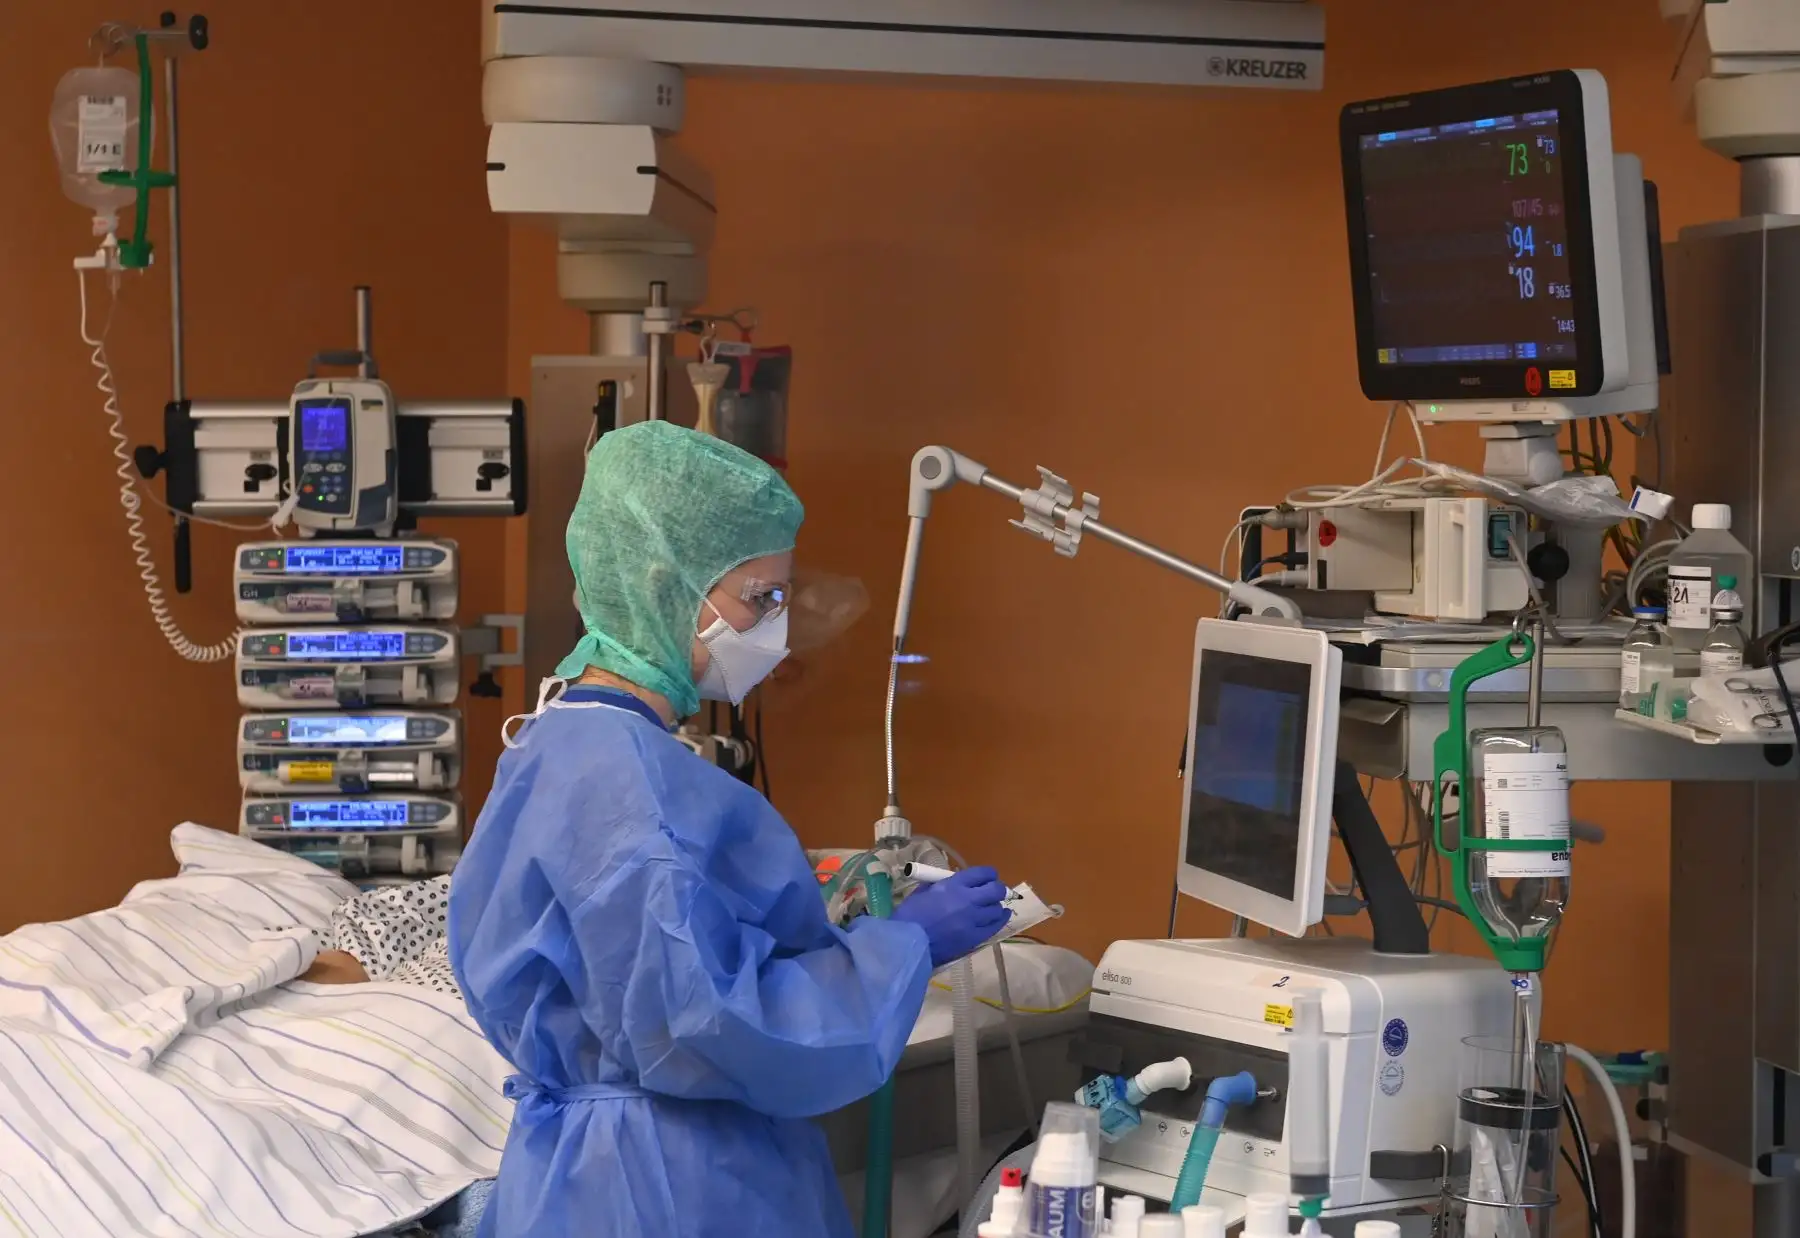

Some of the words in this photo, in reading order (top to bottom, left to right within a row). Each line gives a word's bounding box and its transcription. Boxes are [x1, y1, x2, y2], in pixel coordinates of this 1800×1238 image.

[1226, 59, 1307, 80] KREUZER
[1506, 143, 1528, 176] 73
[1512, 225, 1535, 258] 94
[1515, 266, 1535, 299] 18
[1102, 968, 1119, 983] elisa
[1272, 975, 1290, 988] 2
